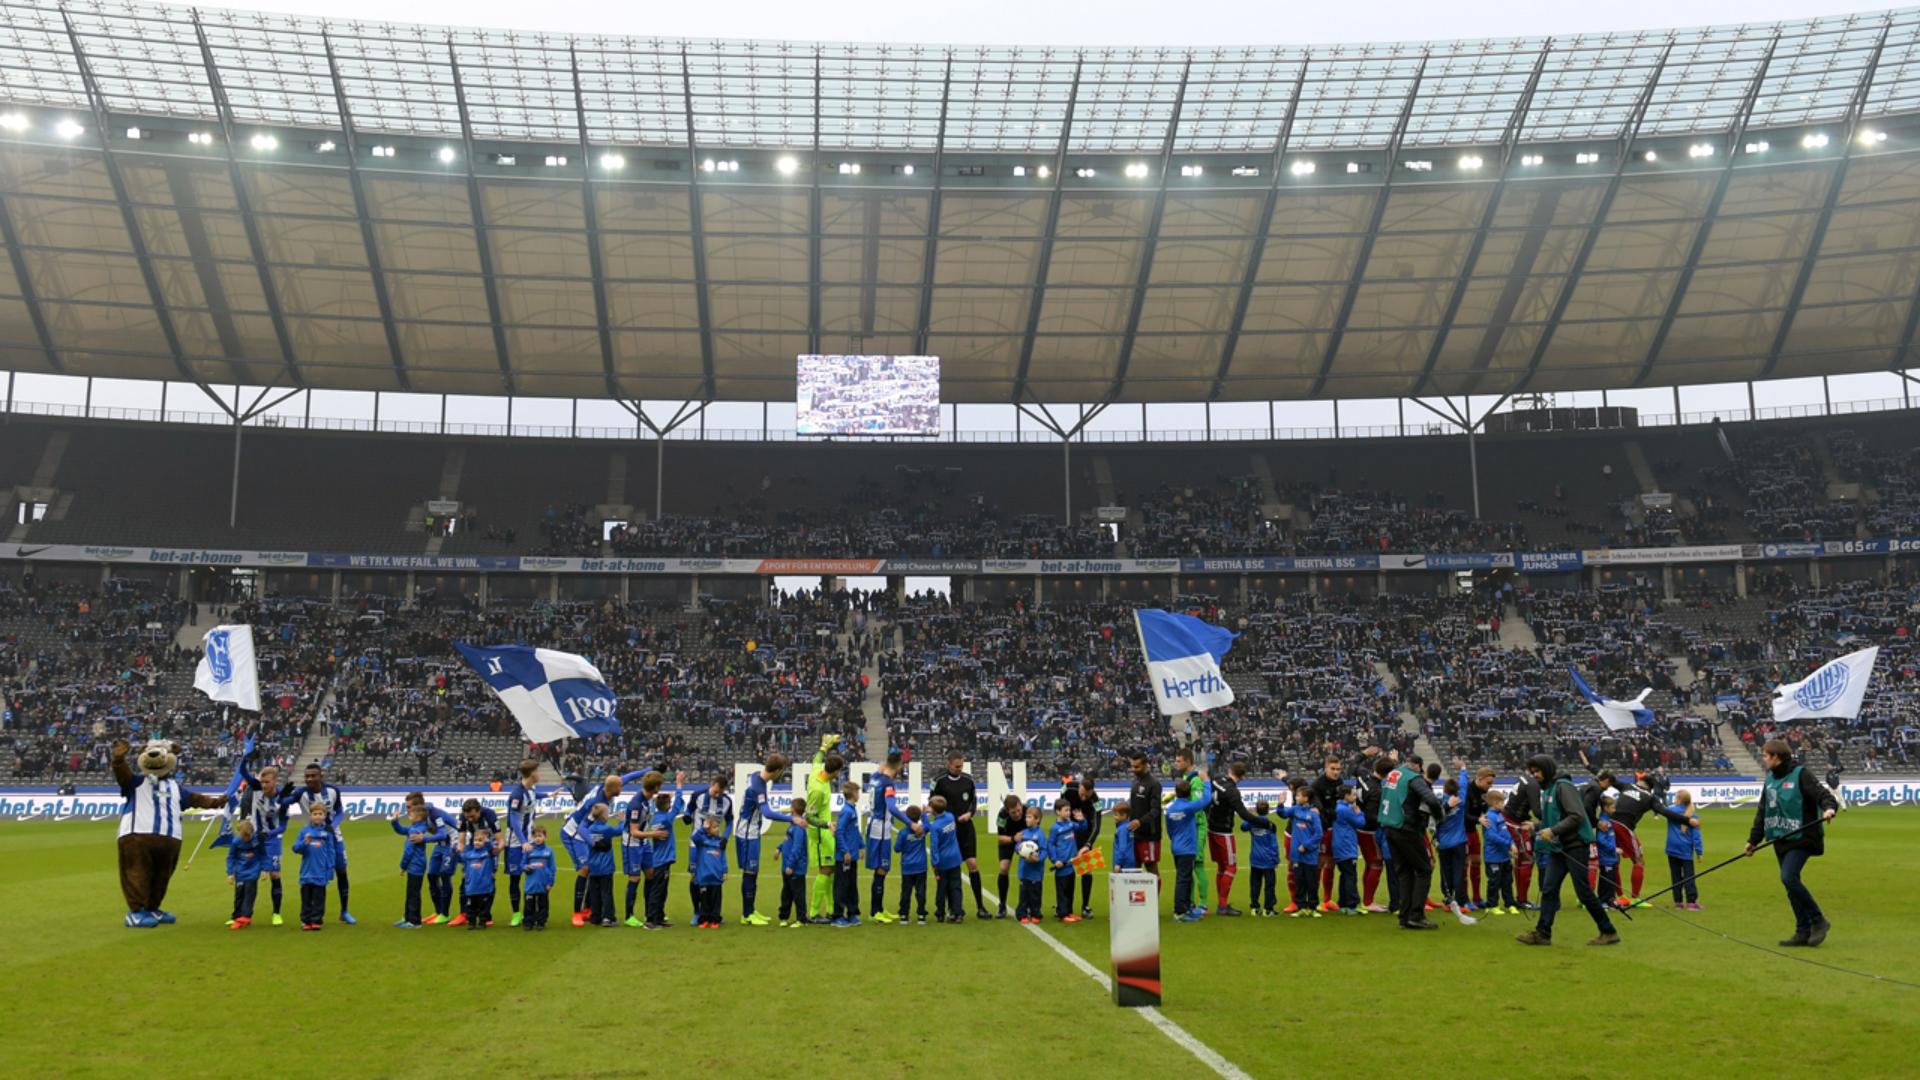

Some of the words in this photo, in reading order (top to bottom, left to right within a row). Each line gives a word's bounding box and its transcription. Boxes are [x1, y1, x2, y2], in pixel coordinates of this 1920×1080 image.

[149, 549, 242, 564] bet-at-home
[350, 556, 367, 566] WE
[369, 556, 391, 567] TRY.
[392, 556, 409, 567] WE
[410, 557, 436, 567] FAIL.
[437, 557, 453, 568] WE
[456, 557, 480, 568] WIN.
[1521, 552, 1577, 562] BERLINER
[580, 559, 666, 571] bet-at-home
[764, 562, 791, 571] SPORT
[792, 560, 809, 571] FÜR
[810, 562, 871, 571] ENTWICKLUNG
[887, 562, 908, 571] 1.000
[909, 561, 940, 571] Chancen
[942, 561, 954, 571] für
[955, 561, 978, 571] Afrika
[1041, 561, 1123, 573] bet-at-home
[1204, 560, 1243, 570] HERTHA
[1246, 559, 1265, 569] BSC
[1294, 559, 1333, 569] HERTHA
[1336, 558, 1356, 568] BSC
[1522, 561, 1559, 570] JUNGS
[1701, 787, 1760, 797] bet-at-home
[0, 798, 125, 816] bet-at-hom
